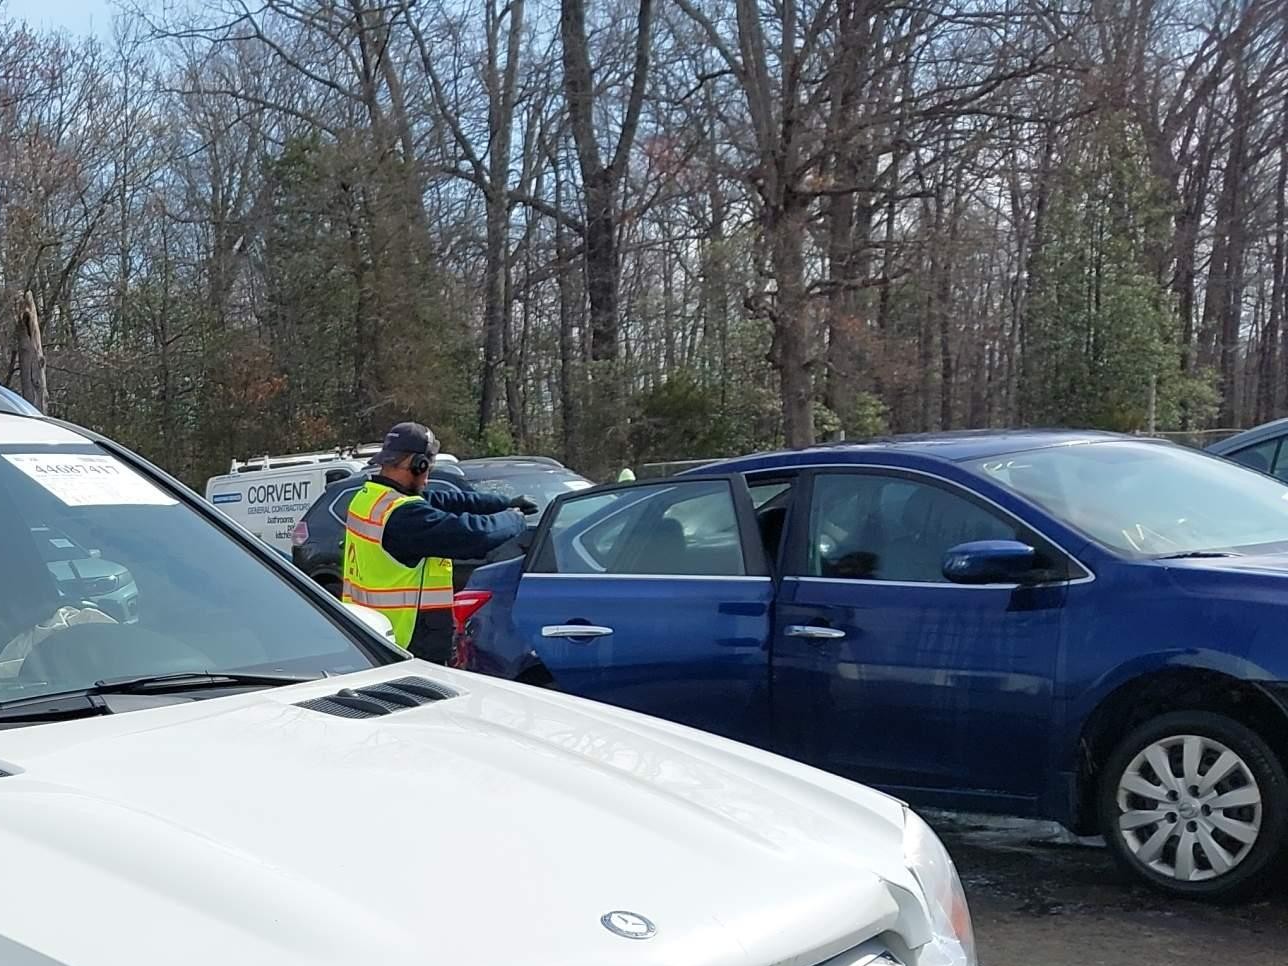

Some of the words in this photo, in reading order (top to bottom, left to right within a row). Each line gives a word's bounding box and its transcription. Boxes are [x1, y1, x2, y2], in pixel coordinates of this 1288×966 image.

[35, 464, 121, 475] 44687417
[247, 481, 312, 504] CORVENT
[247, 506, 271, 515] GENERAL
